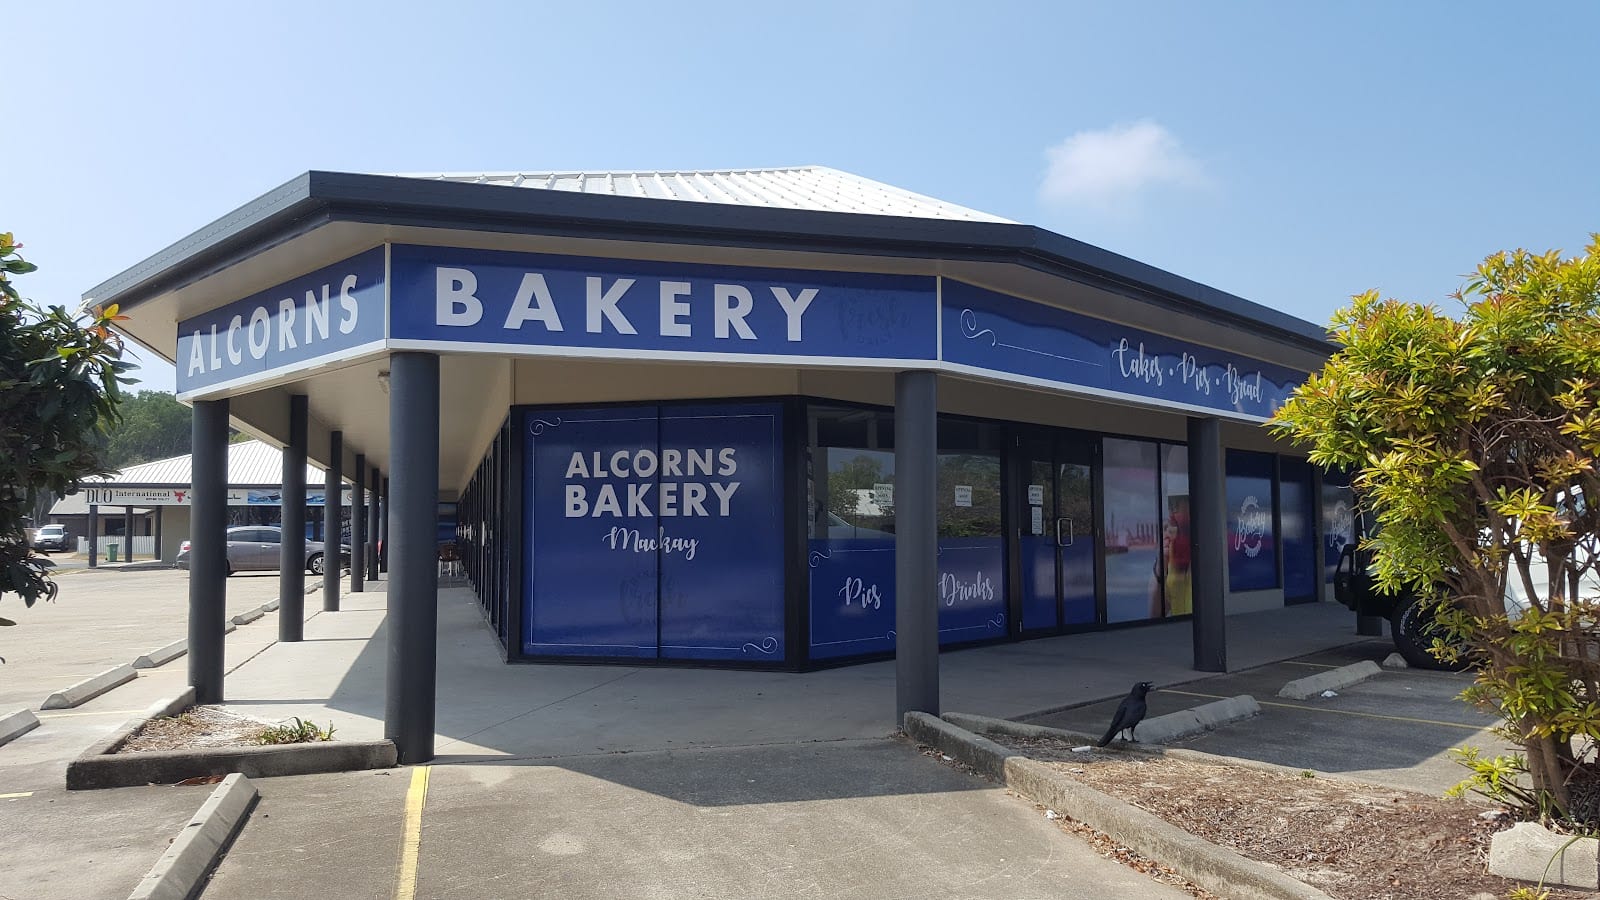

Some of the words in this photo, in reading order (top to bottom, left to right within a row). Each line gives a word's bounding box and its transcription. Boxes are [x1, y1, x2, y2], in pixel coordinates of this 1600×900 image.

[436, 266, 819, 342] BAKERY
[187, 274, 359, 377] ALCORNS
[1112, 338, 1163, 387] Cakes
[1176, 352, 1210, 396] Pies
[1222, 363, 1263, 404] Bread
[565, 448, 737, 478] ALCORNS
[86, 488, 113, 504] DUO
[565, 482, 741, 518] BAKERY
[602, 526, 699, 560] Mackay
[838, 576, 882, 610] Pies
[939, 571, 994, 607] Drinks
